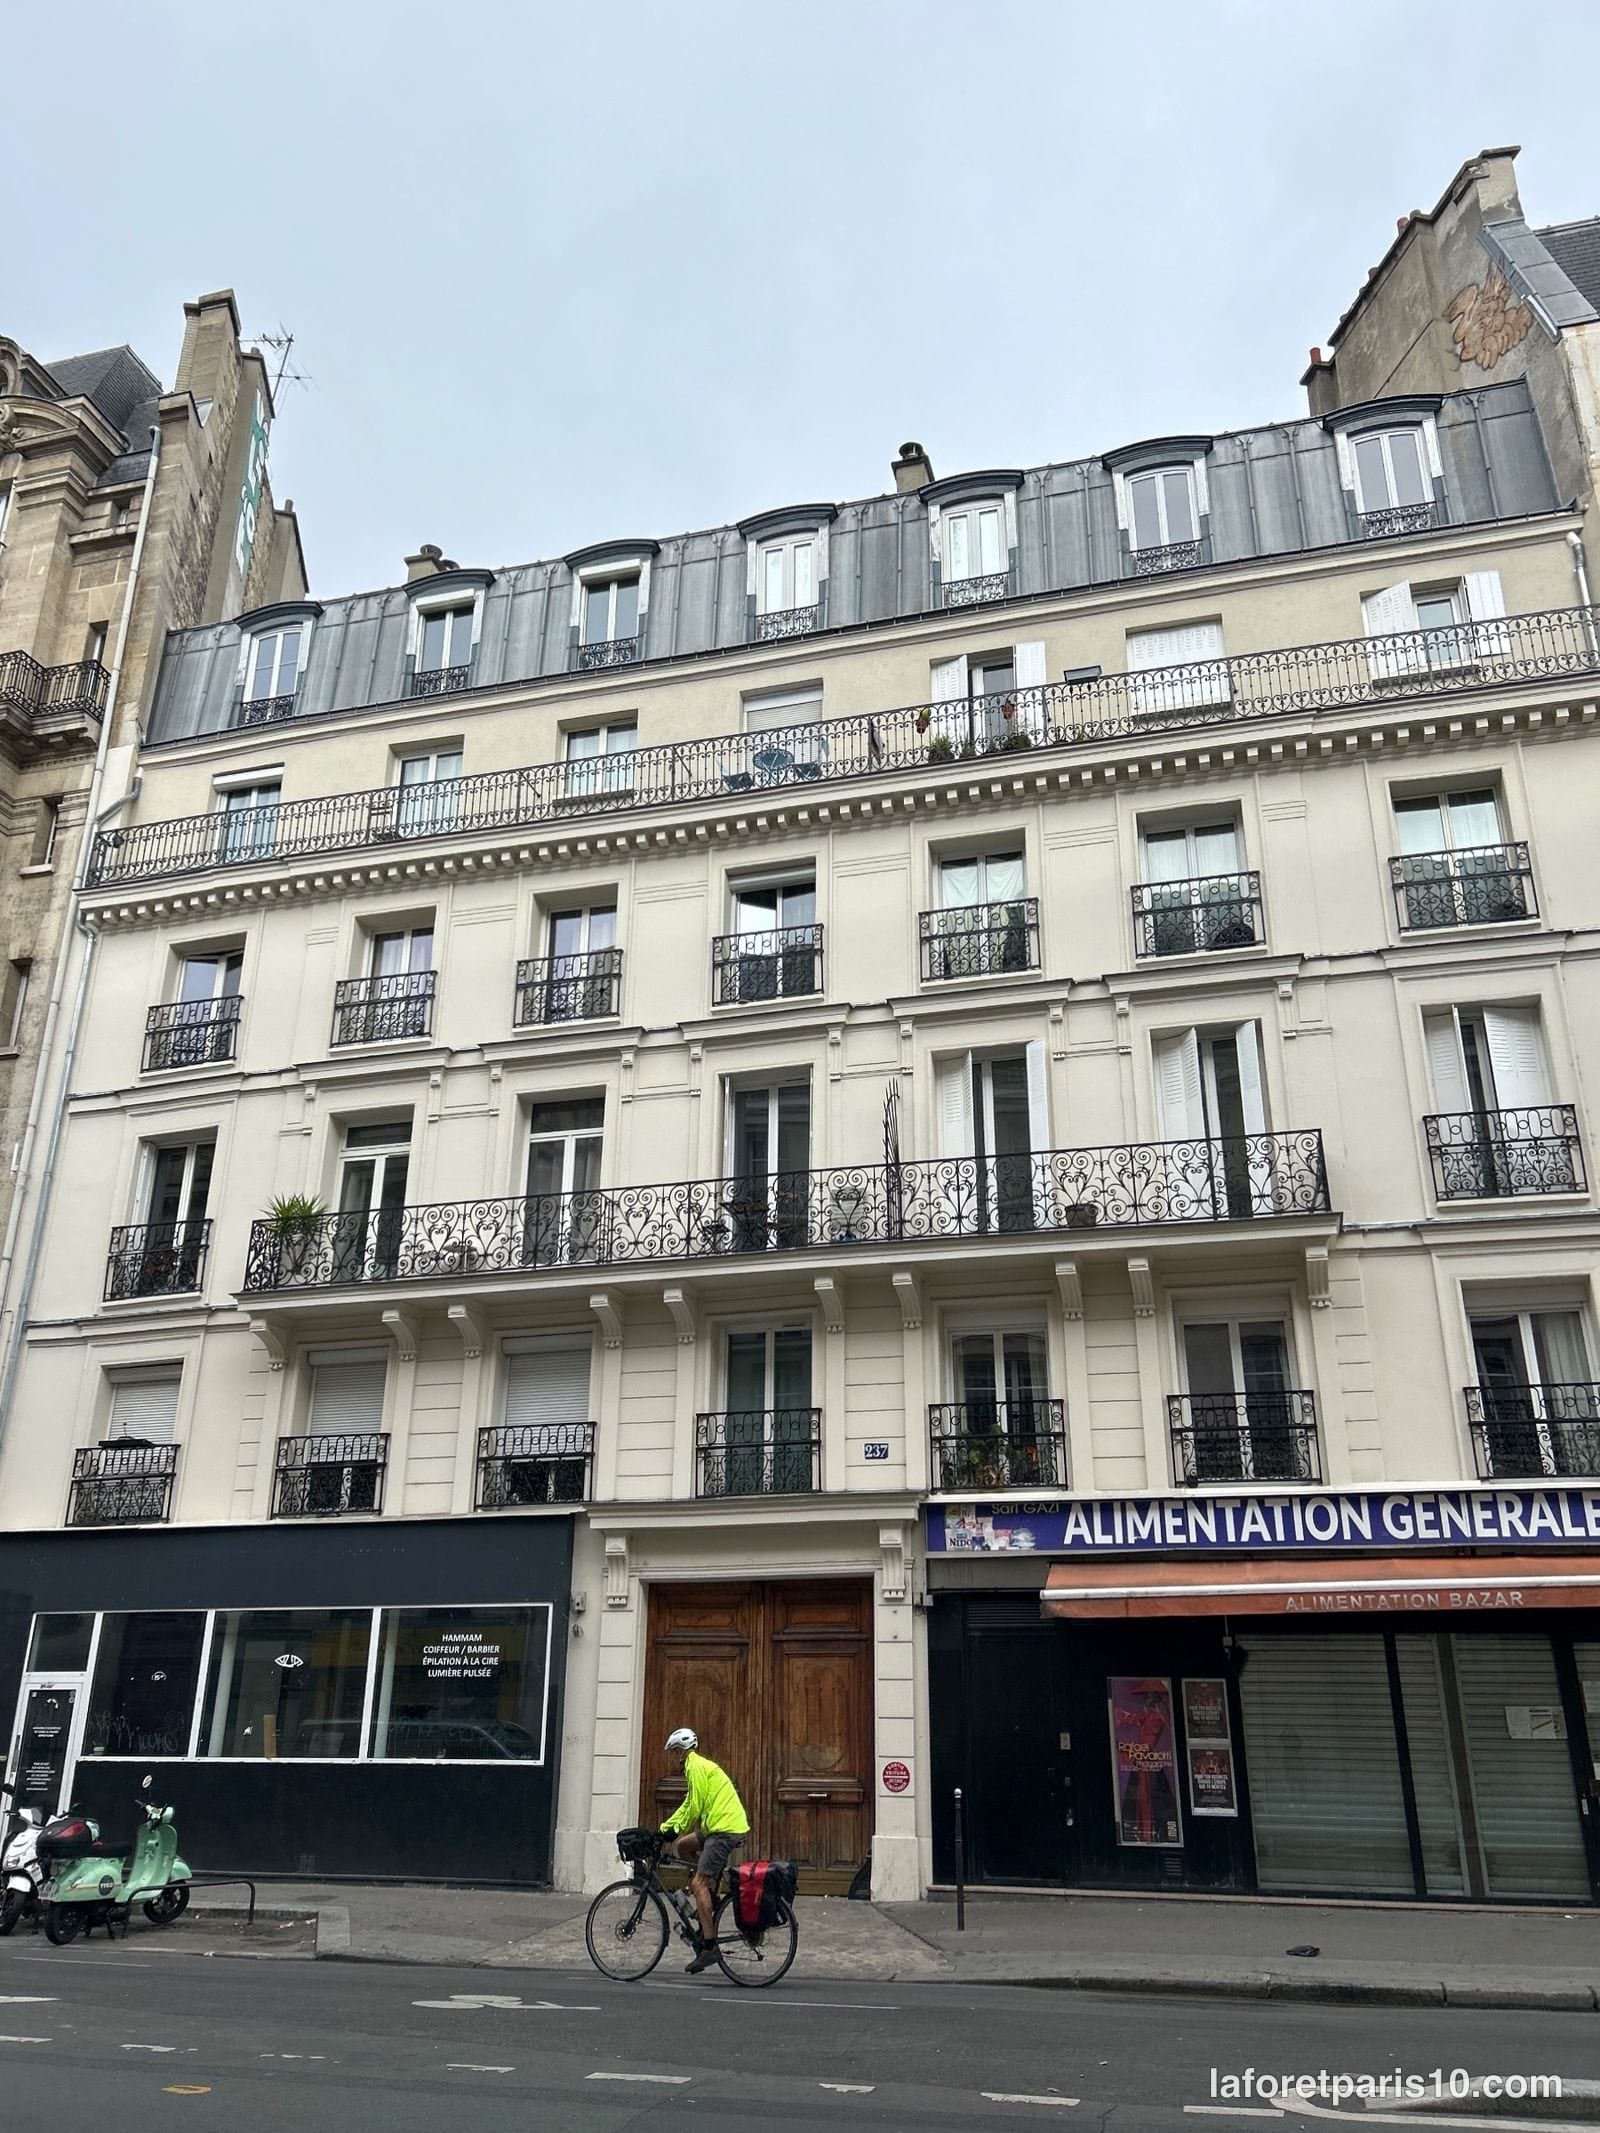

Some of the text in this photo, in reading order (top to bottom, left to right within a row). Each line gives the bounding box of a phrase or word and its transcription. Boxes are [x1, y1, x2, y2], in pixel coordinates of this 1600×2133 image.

[865, 1444, 888, 1458] 237
[1023, 1503, 1060, 1514] GAZI
[1063, 1491, 1600, 1545] ALIMENTATION GENERALE
[1286, 1590, 1525, 1611] ALIMENTATION BAZAR
[442, 1633, 483, 1642] HAMMAM
[423, 1645, 460, 1654] COIFFEUR
[467, 1645, 500, 1654] BARBIER
[422, 1655, 499, 1666] ÉPILATION À LA CIRE
[427, 1667, 492, 1677] LUMIÈRE PULSÉE
